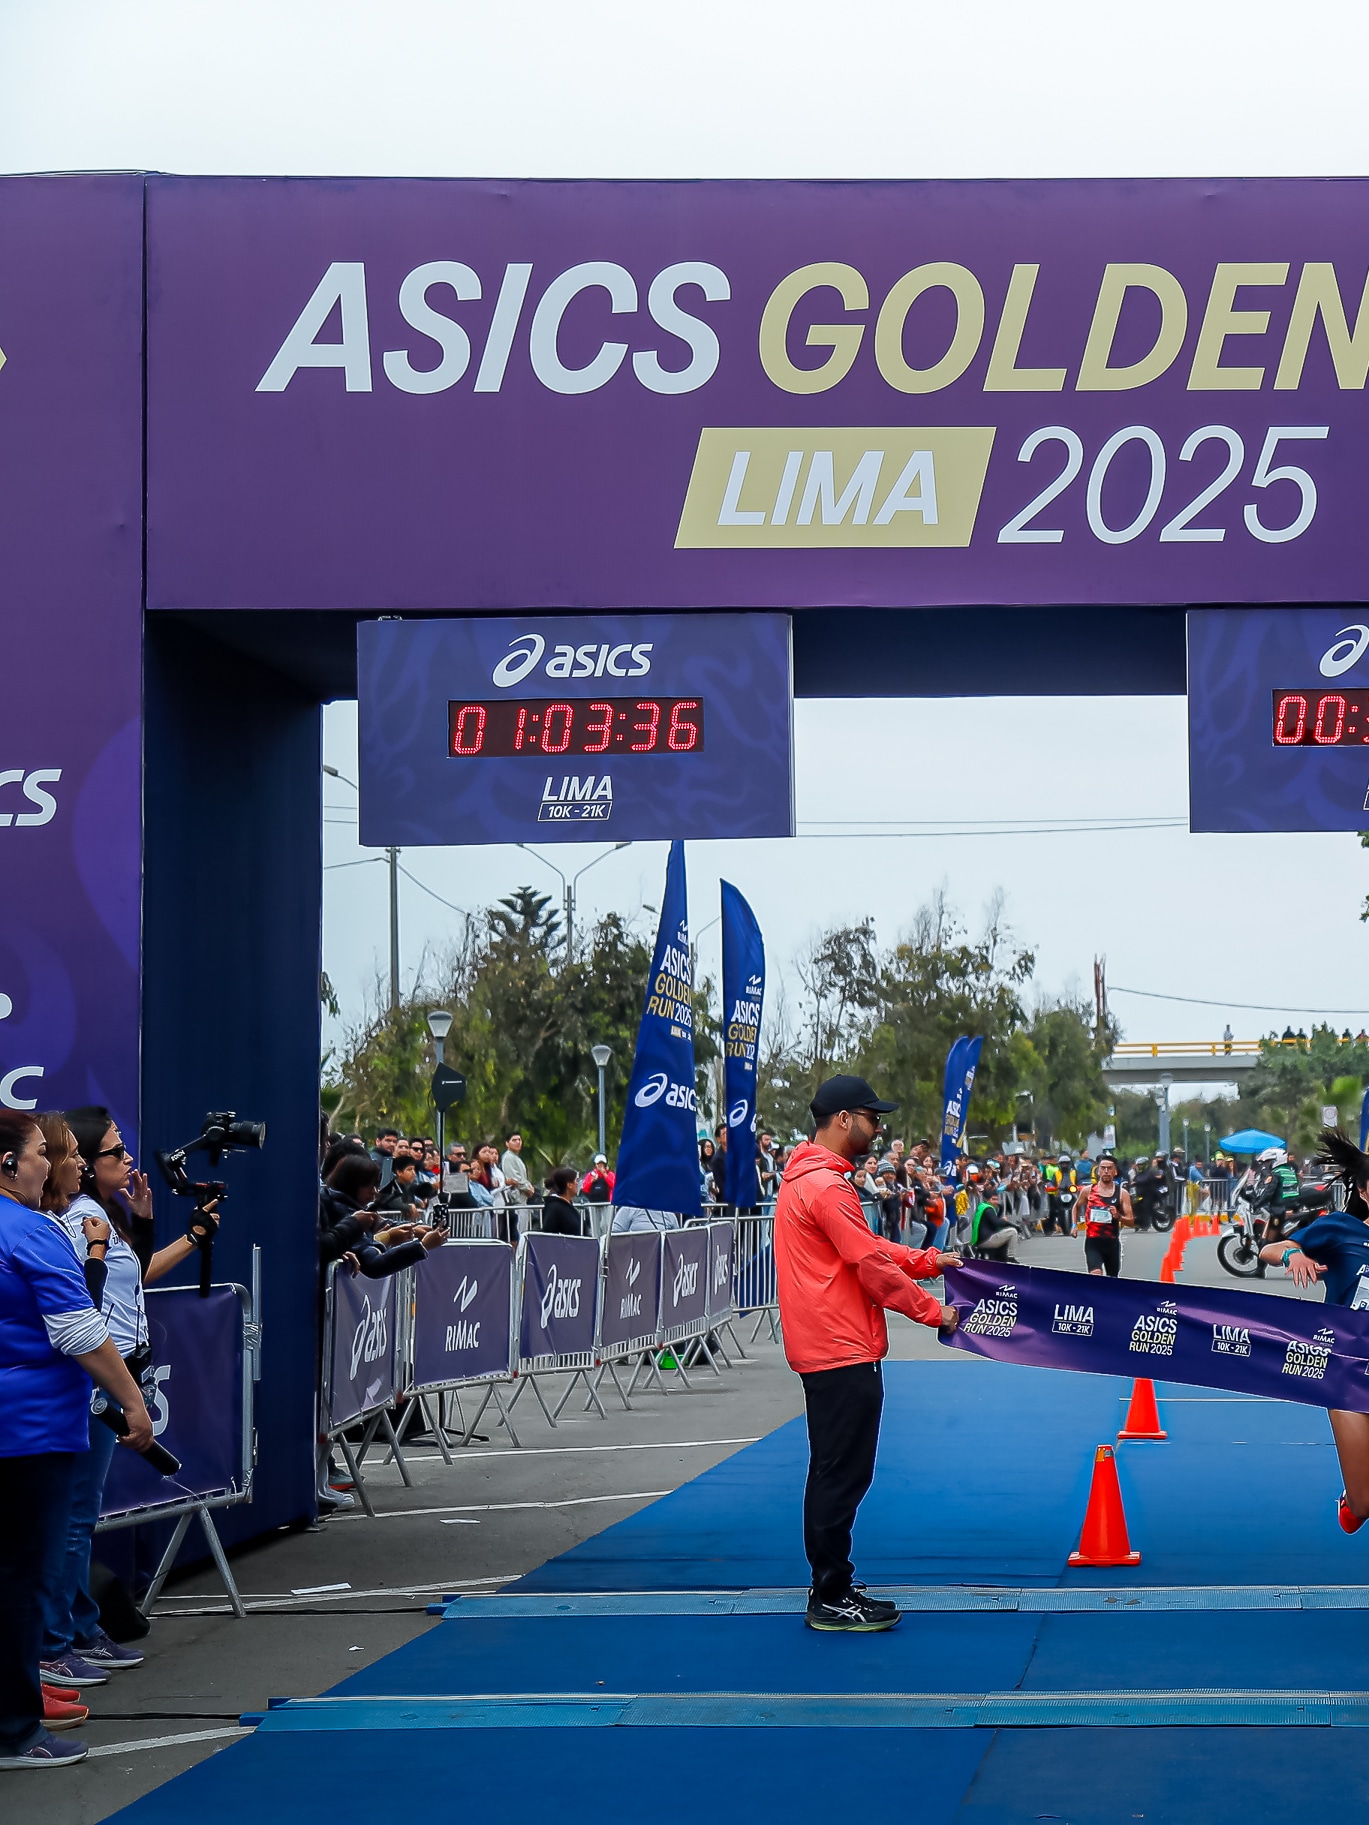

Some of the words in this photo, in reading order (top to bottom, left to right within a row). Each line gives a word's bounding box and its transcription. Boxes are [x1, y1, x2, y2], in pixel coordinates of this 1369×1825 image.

[255, 260, 731, 395] ASICS
[717, 451, 939, 526] LIMA
[997, 425, 1330, 544] 2025
[546, 642, 653, 679] asics
[542, 776, 613, 801] LIMA
[646, 996, 675, 1020] RUN
[731, 1000, 760, 1026] ASICS
[666, 1083, 696, 1112] asic
[974, 1298, 1018, 1316] ASICS
[1054, 1303, 1094, 1324] LIMA
[963, 1323, 986, 1335] RUN
[987, 1326, 1012, 1337] 2025
[969, 1313, 1017, 1328] GOLDEN
[1134, 1315, 1178, 1334] ASICS
[445, 1319, 480, 1352] RIMAC
[1131, 1330, 1176, 1345] GOLDEN
[1213, 1324, 1250, 1344] LIMA
[1129, 1341, 1149, 1354] RUN
[1150, 1343, 1173, 1356] 2025
[1286, 1352, 1328, 1369] GOLDEN
[1282, 1363, 1303, 1376] RUN
[1303, 1366, 1325, 1380] 2025
